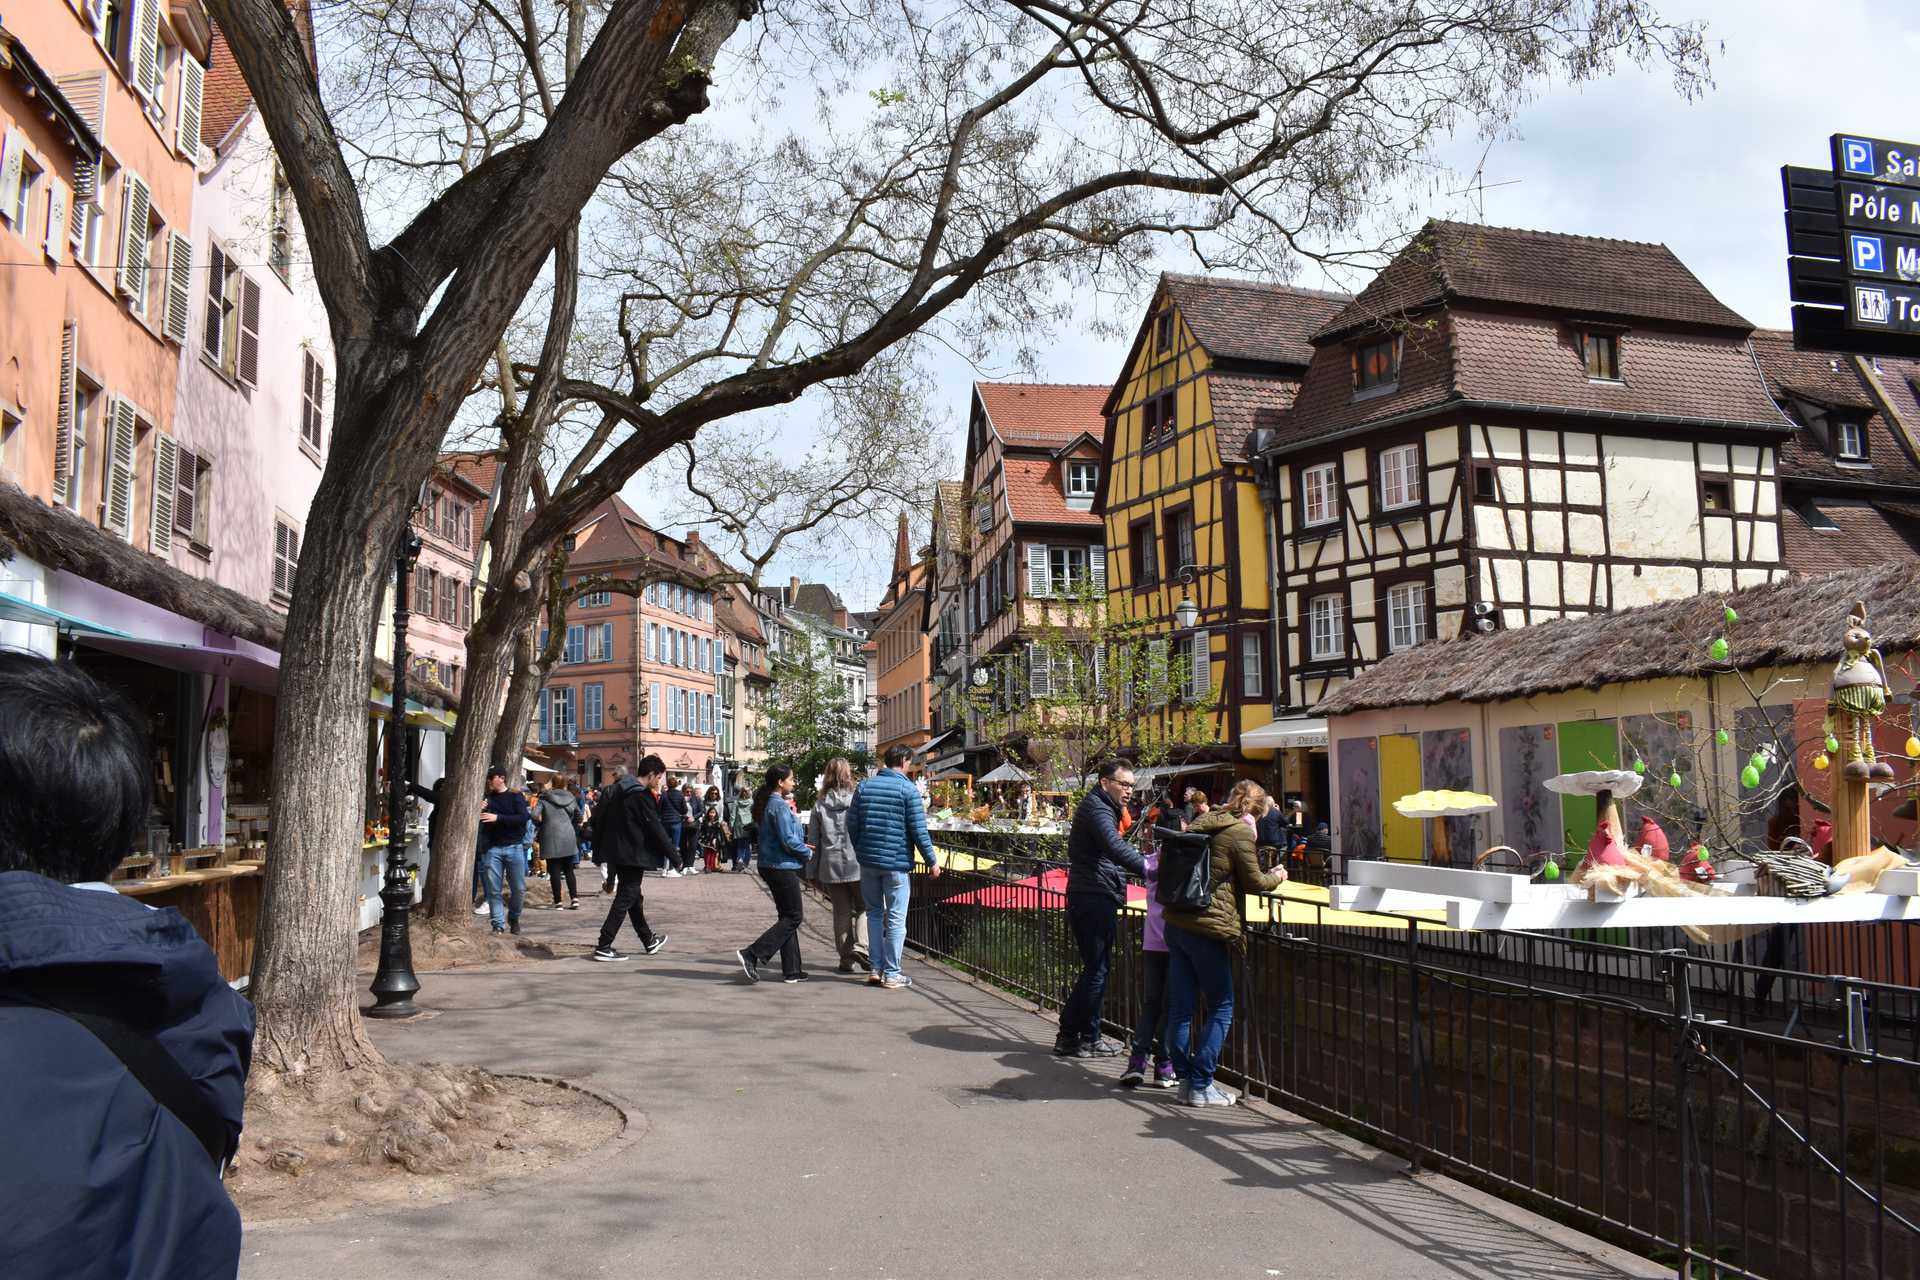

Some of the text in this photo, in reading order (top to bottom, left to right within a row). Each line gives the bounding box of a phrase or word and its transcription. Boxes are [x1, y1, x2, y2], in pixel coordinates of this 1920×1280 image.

[1848, 144, 1866, 170] P
[1850, 193, 1900, 222] Pôle
[1857, 241, 1876, 267] P
